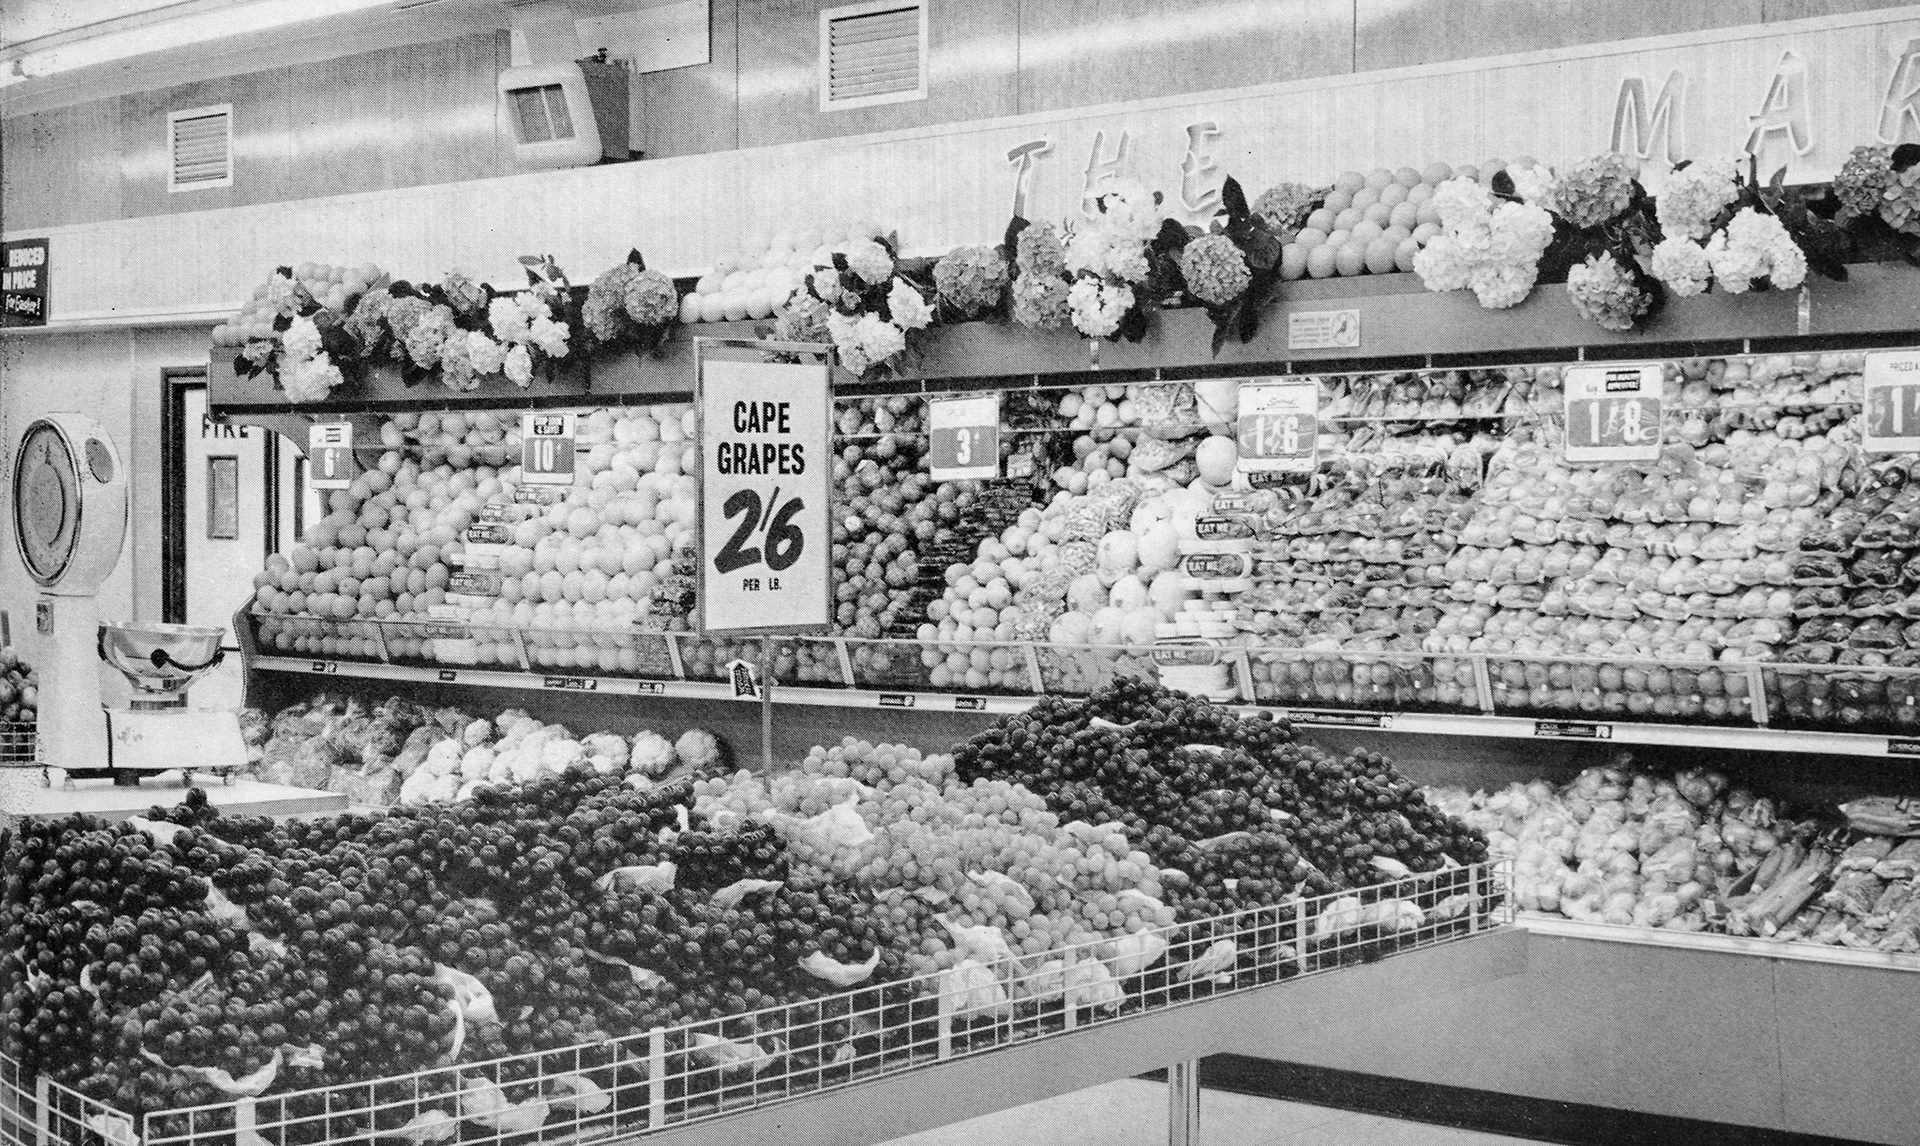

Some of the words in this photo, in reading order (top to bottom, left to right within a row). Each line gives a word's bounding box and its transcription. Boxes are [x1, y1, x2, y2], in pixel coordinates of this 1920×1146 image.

[1007, 121, 1221, 216] THE
[734, 401, 791, 433] CAPE
[717, 442, 805, 475] GRAPES
[714, 486, 806, 575] 2/6
[1200, 523, 1214, 533] EAT
[1216, 523, 1230, 533] ME
[1189, 562, 1205, 572] EAT
[1206, 562, 1219, 571] ME
[743, 578, 760, 591] PER
